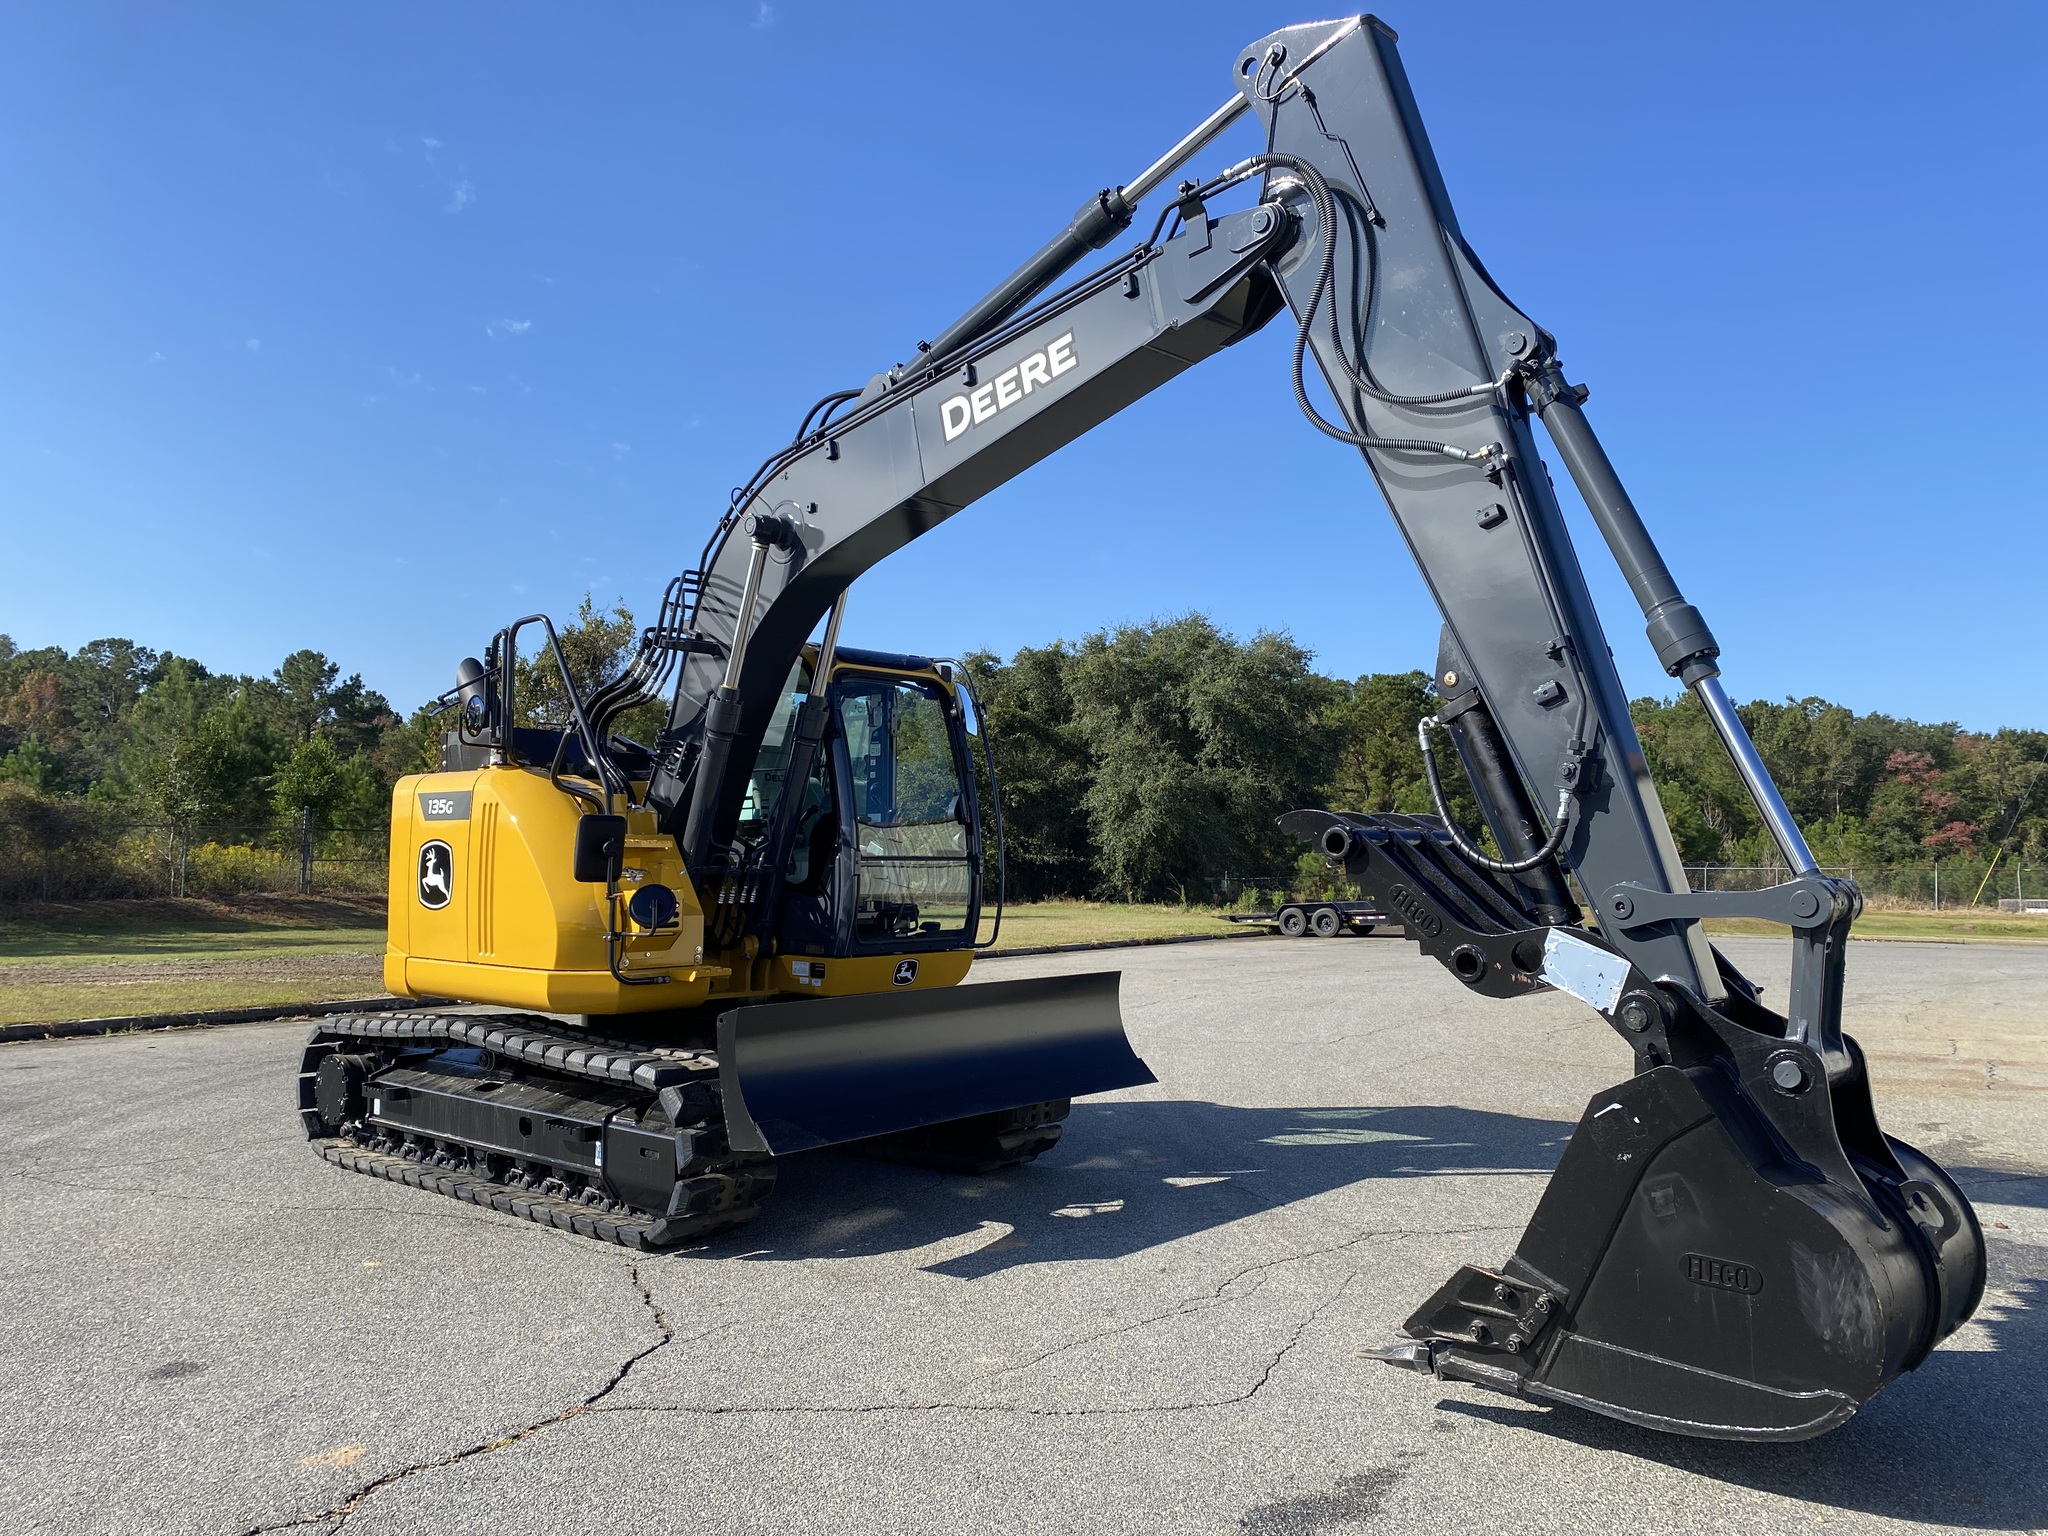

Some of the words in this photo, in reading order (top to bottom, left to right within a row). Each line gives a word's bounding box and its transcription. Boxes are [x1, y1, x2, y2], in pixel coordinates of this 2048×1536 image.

[940, 331, 1078, 442] DEERE
[428, 799, 454, 815] 135G
[1392, 889, 1435, 932] FLECO
[1688, 1255, 1750, 1291] FLECO
